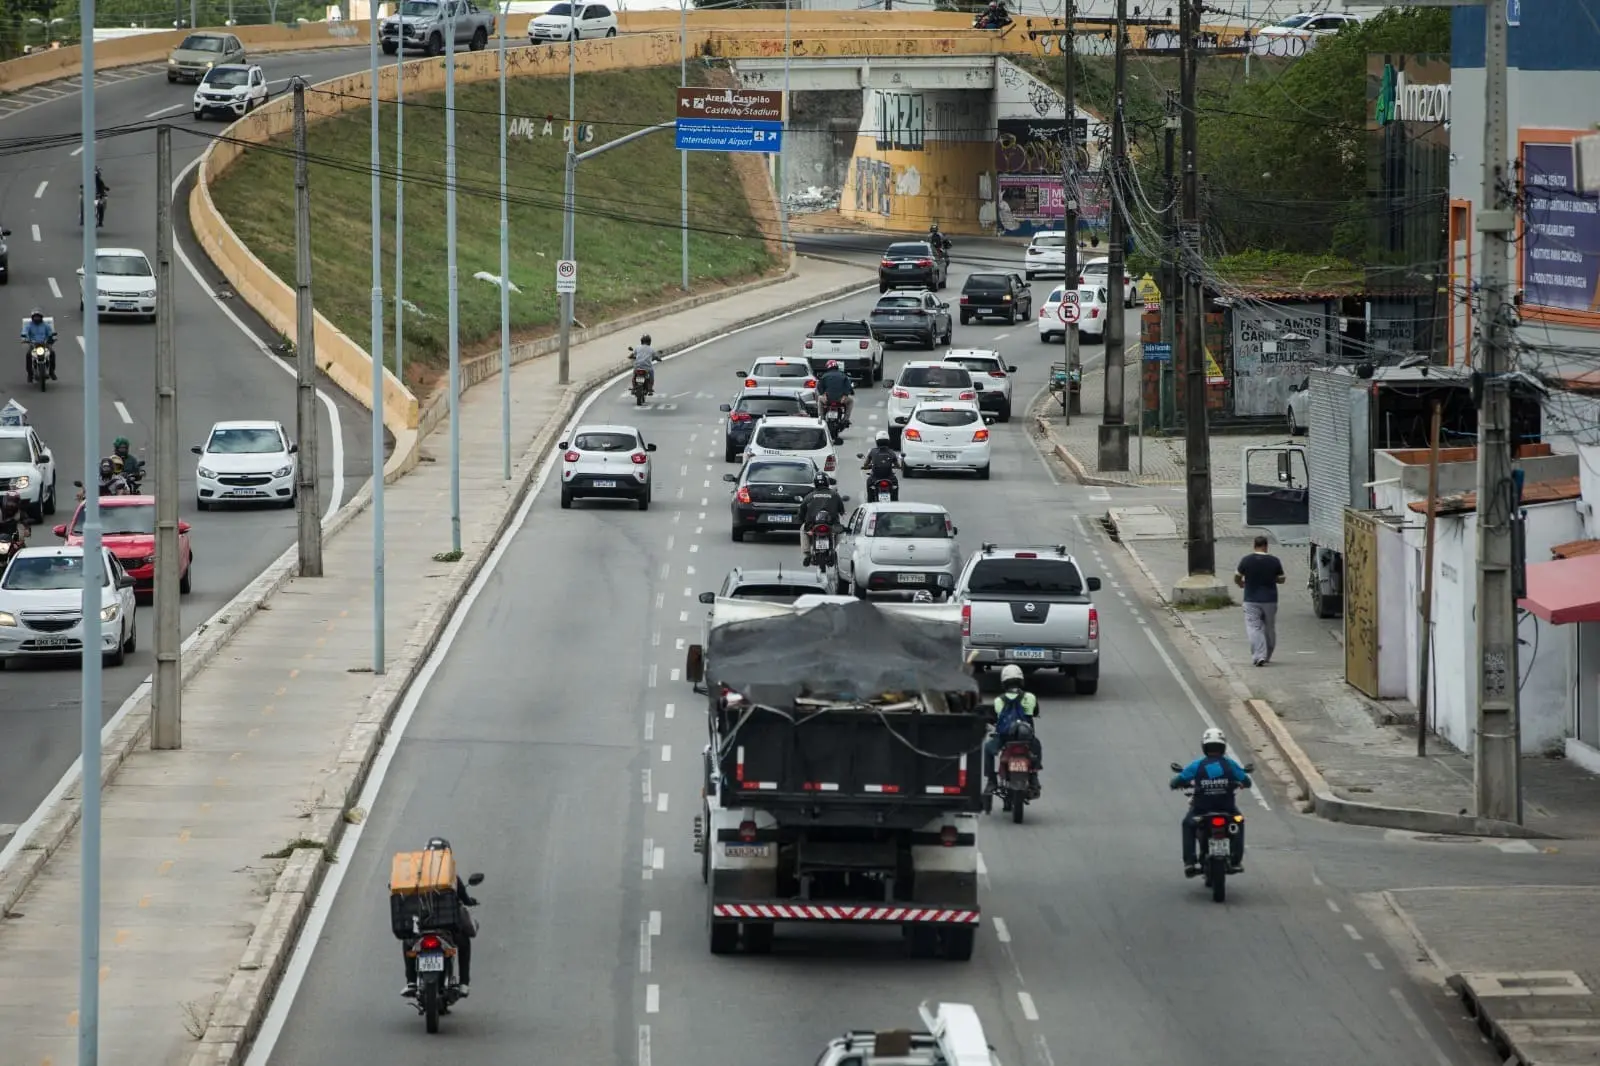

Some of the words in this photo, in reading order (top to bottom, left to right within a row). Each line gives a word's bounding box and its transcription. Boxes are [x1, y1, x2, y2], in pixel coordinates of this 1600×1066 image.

[744, 107, 779, 117] Stadium
[508, 117, 535, 140] AME
[542, 119, 553, 136] A
[681, 136, 726, 145] International
[727, 138, 753, 147] Airport
[561, 265, 572, 273] 80
